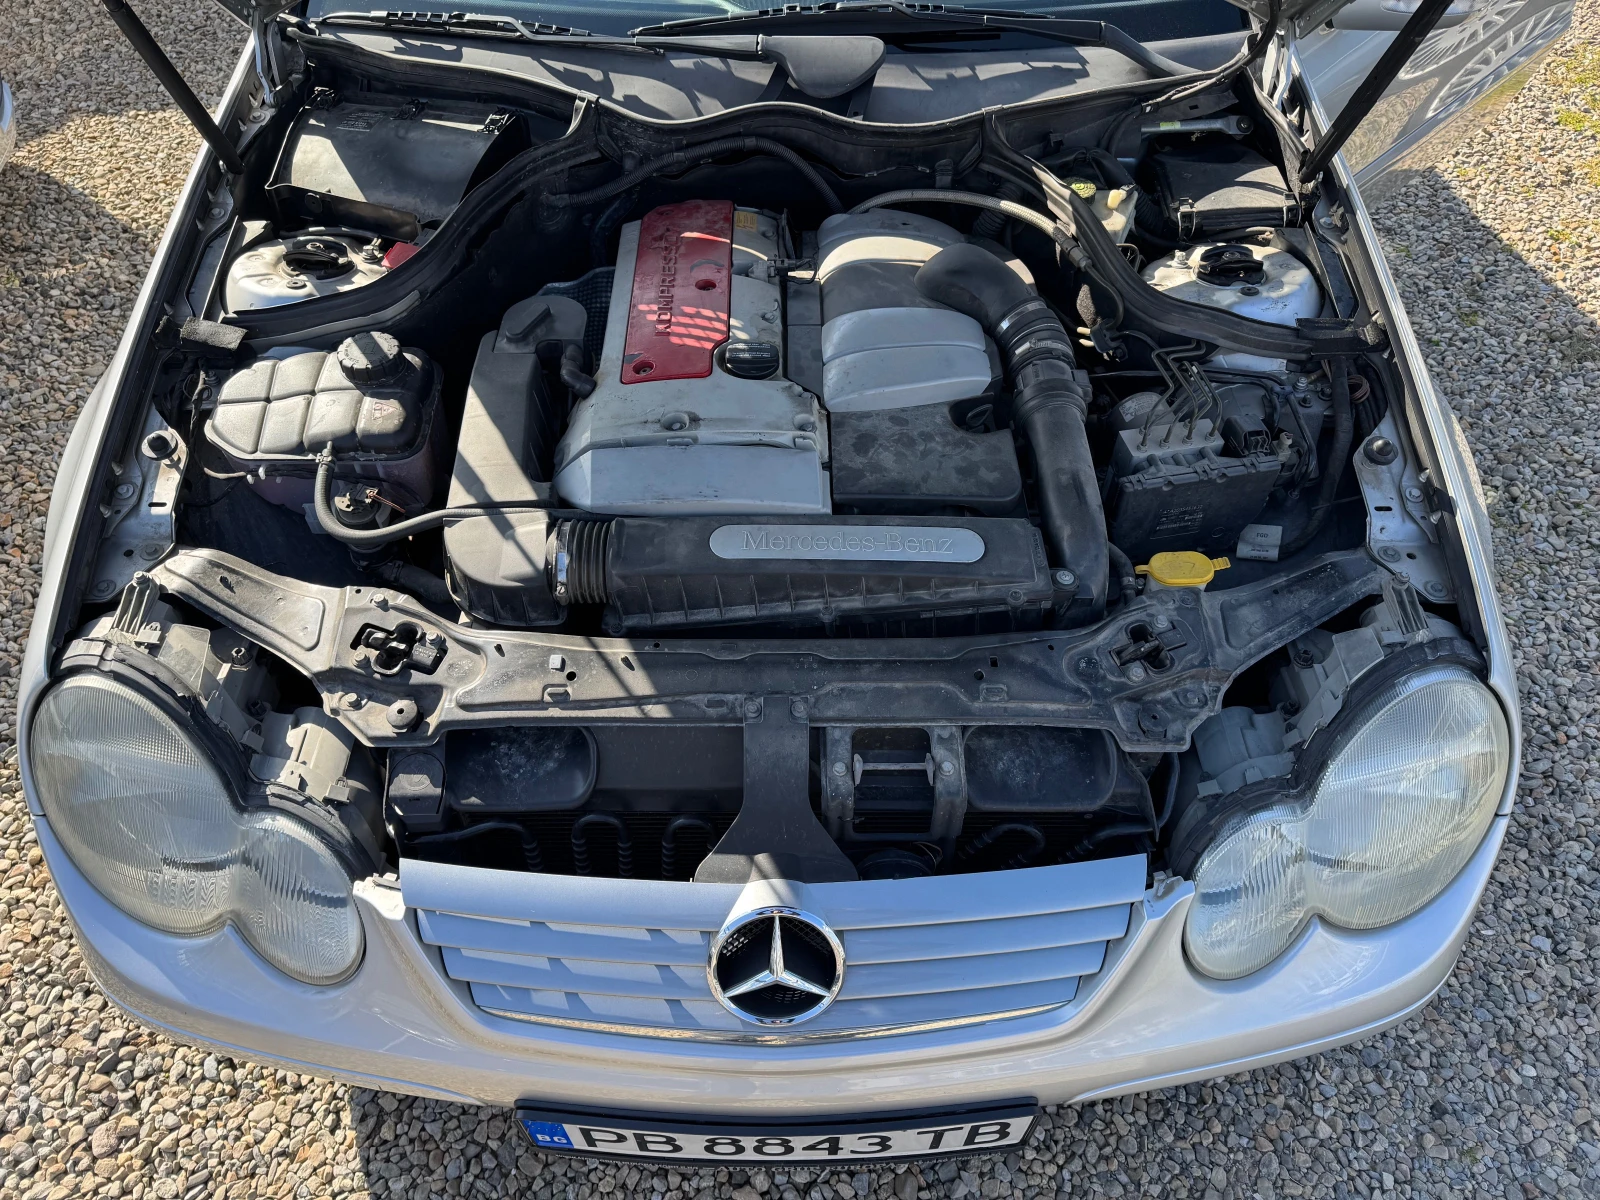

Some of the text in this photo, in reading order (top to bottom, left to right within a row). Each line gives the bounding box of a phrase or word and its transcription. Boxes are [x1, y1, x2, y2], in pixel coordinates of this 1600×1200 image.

[740, 530, 954, 554] Mercedes-Benz
[536, 1134, 567, 1144] BG
[578, 1121, 1012, 1156] PB 8843 TB
